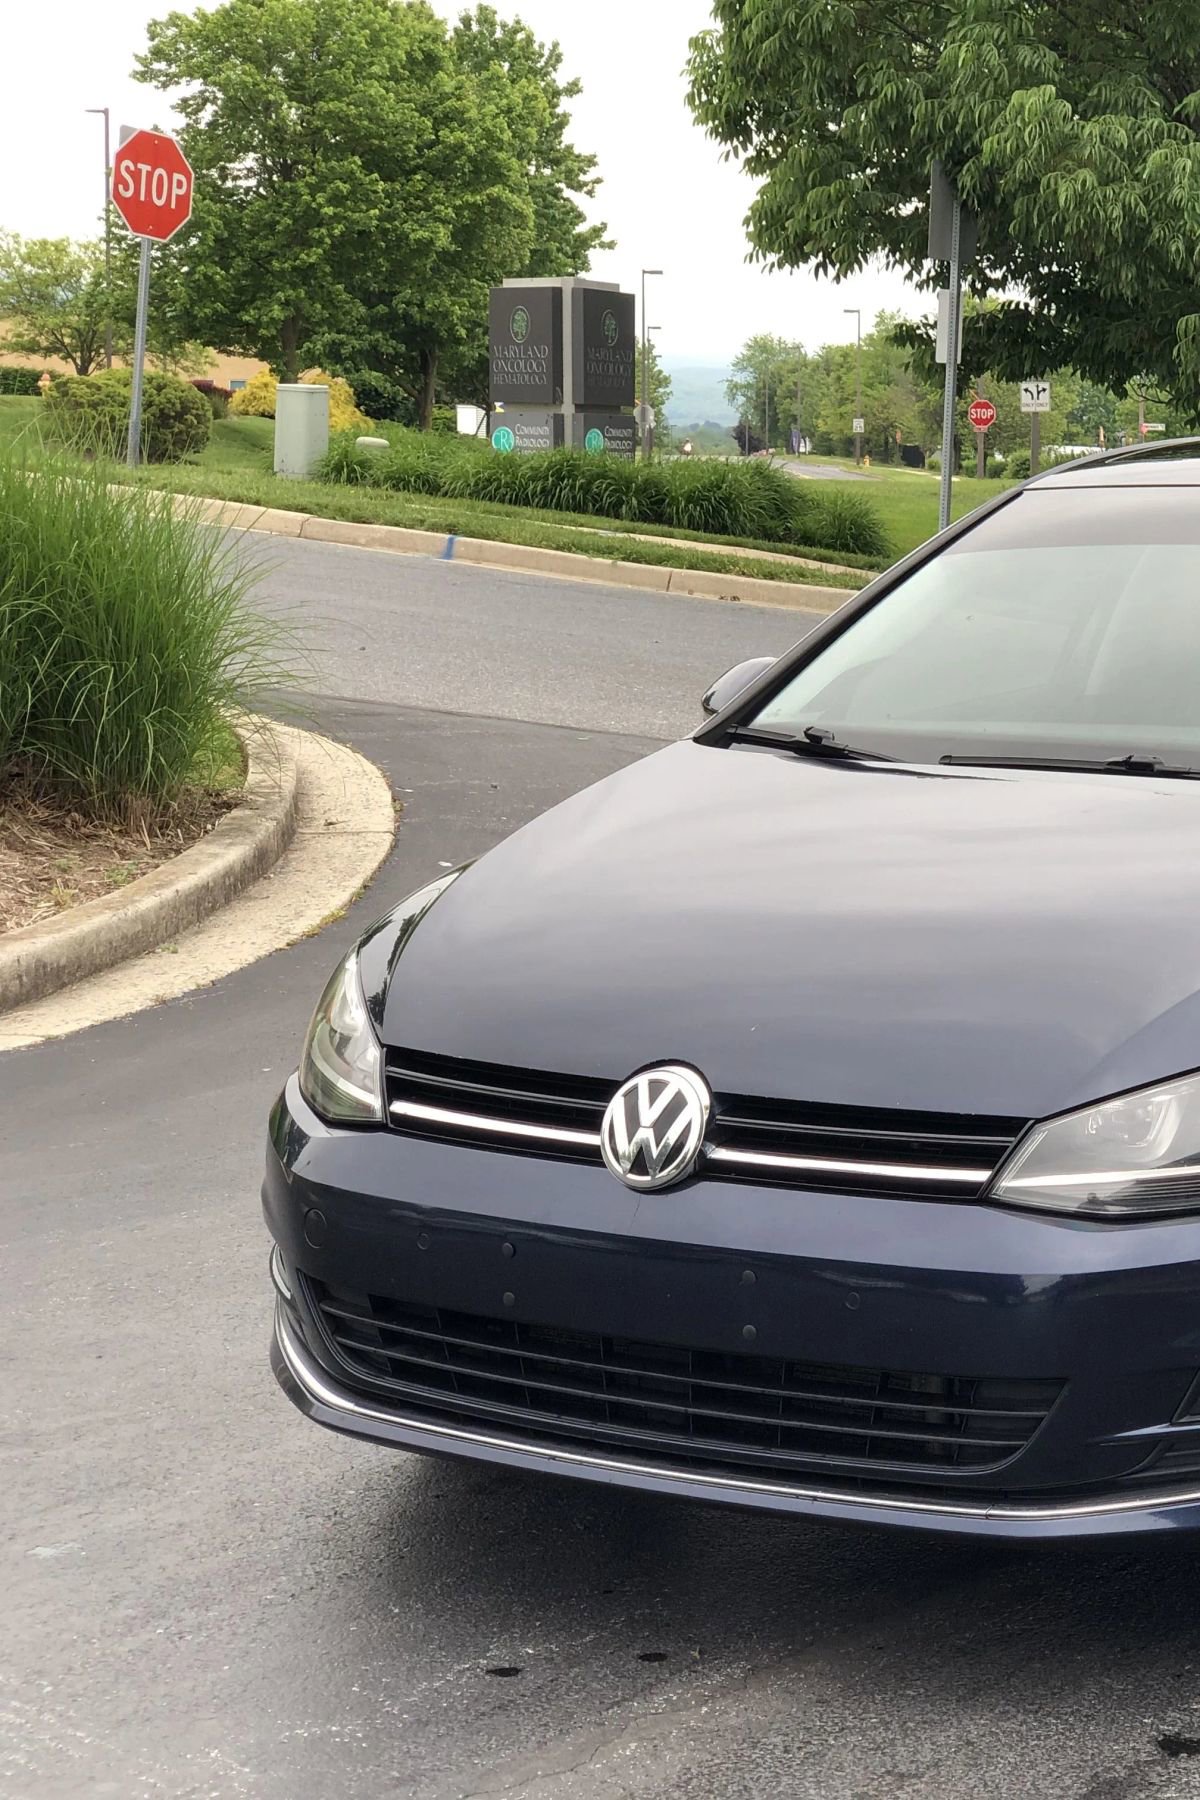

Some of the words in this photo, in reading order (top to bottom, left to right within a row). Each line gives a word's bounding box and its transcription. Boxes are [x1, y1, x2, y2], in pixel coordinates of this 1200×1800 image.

[117, 159, 188, 209] STOP
[493, 345, 549, 358] MARYLAND
[493, 359, 547, 373] ONCOLOGY
[493, 373, 548, 385] HEMATOLOGY
[970, 408, 994, 419] STOP
[515, 436, 550, 448] RADIOLOGY
[608, 1075, 699, 1179] VW
